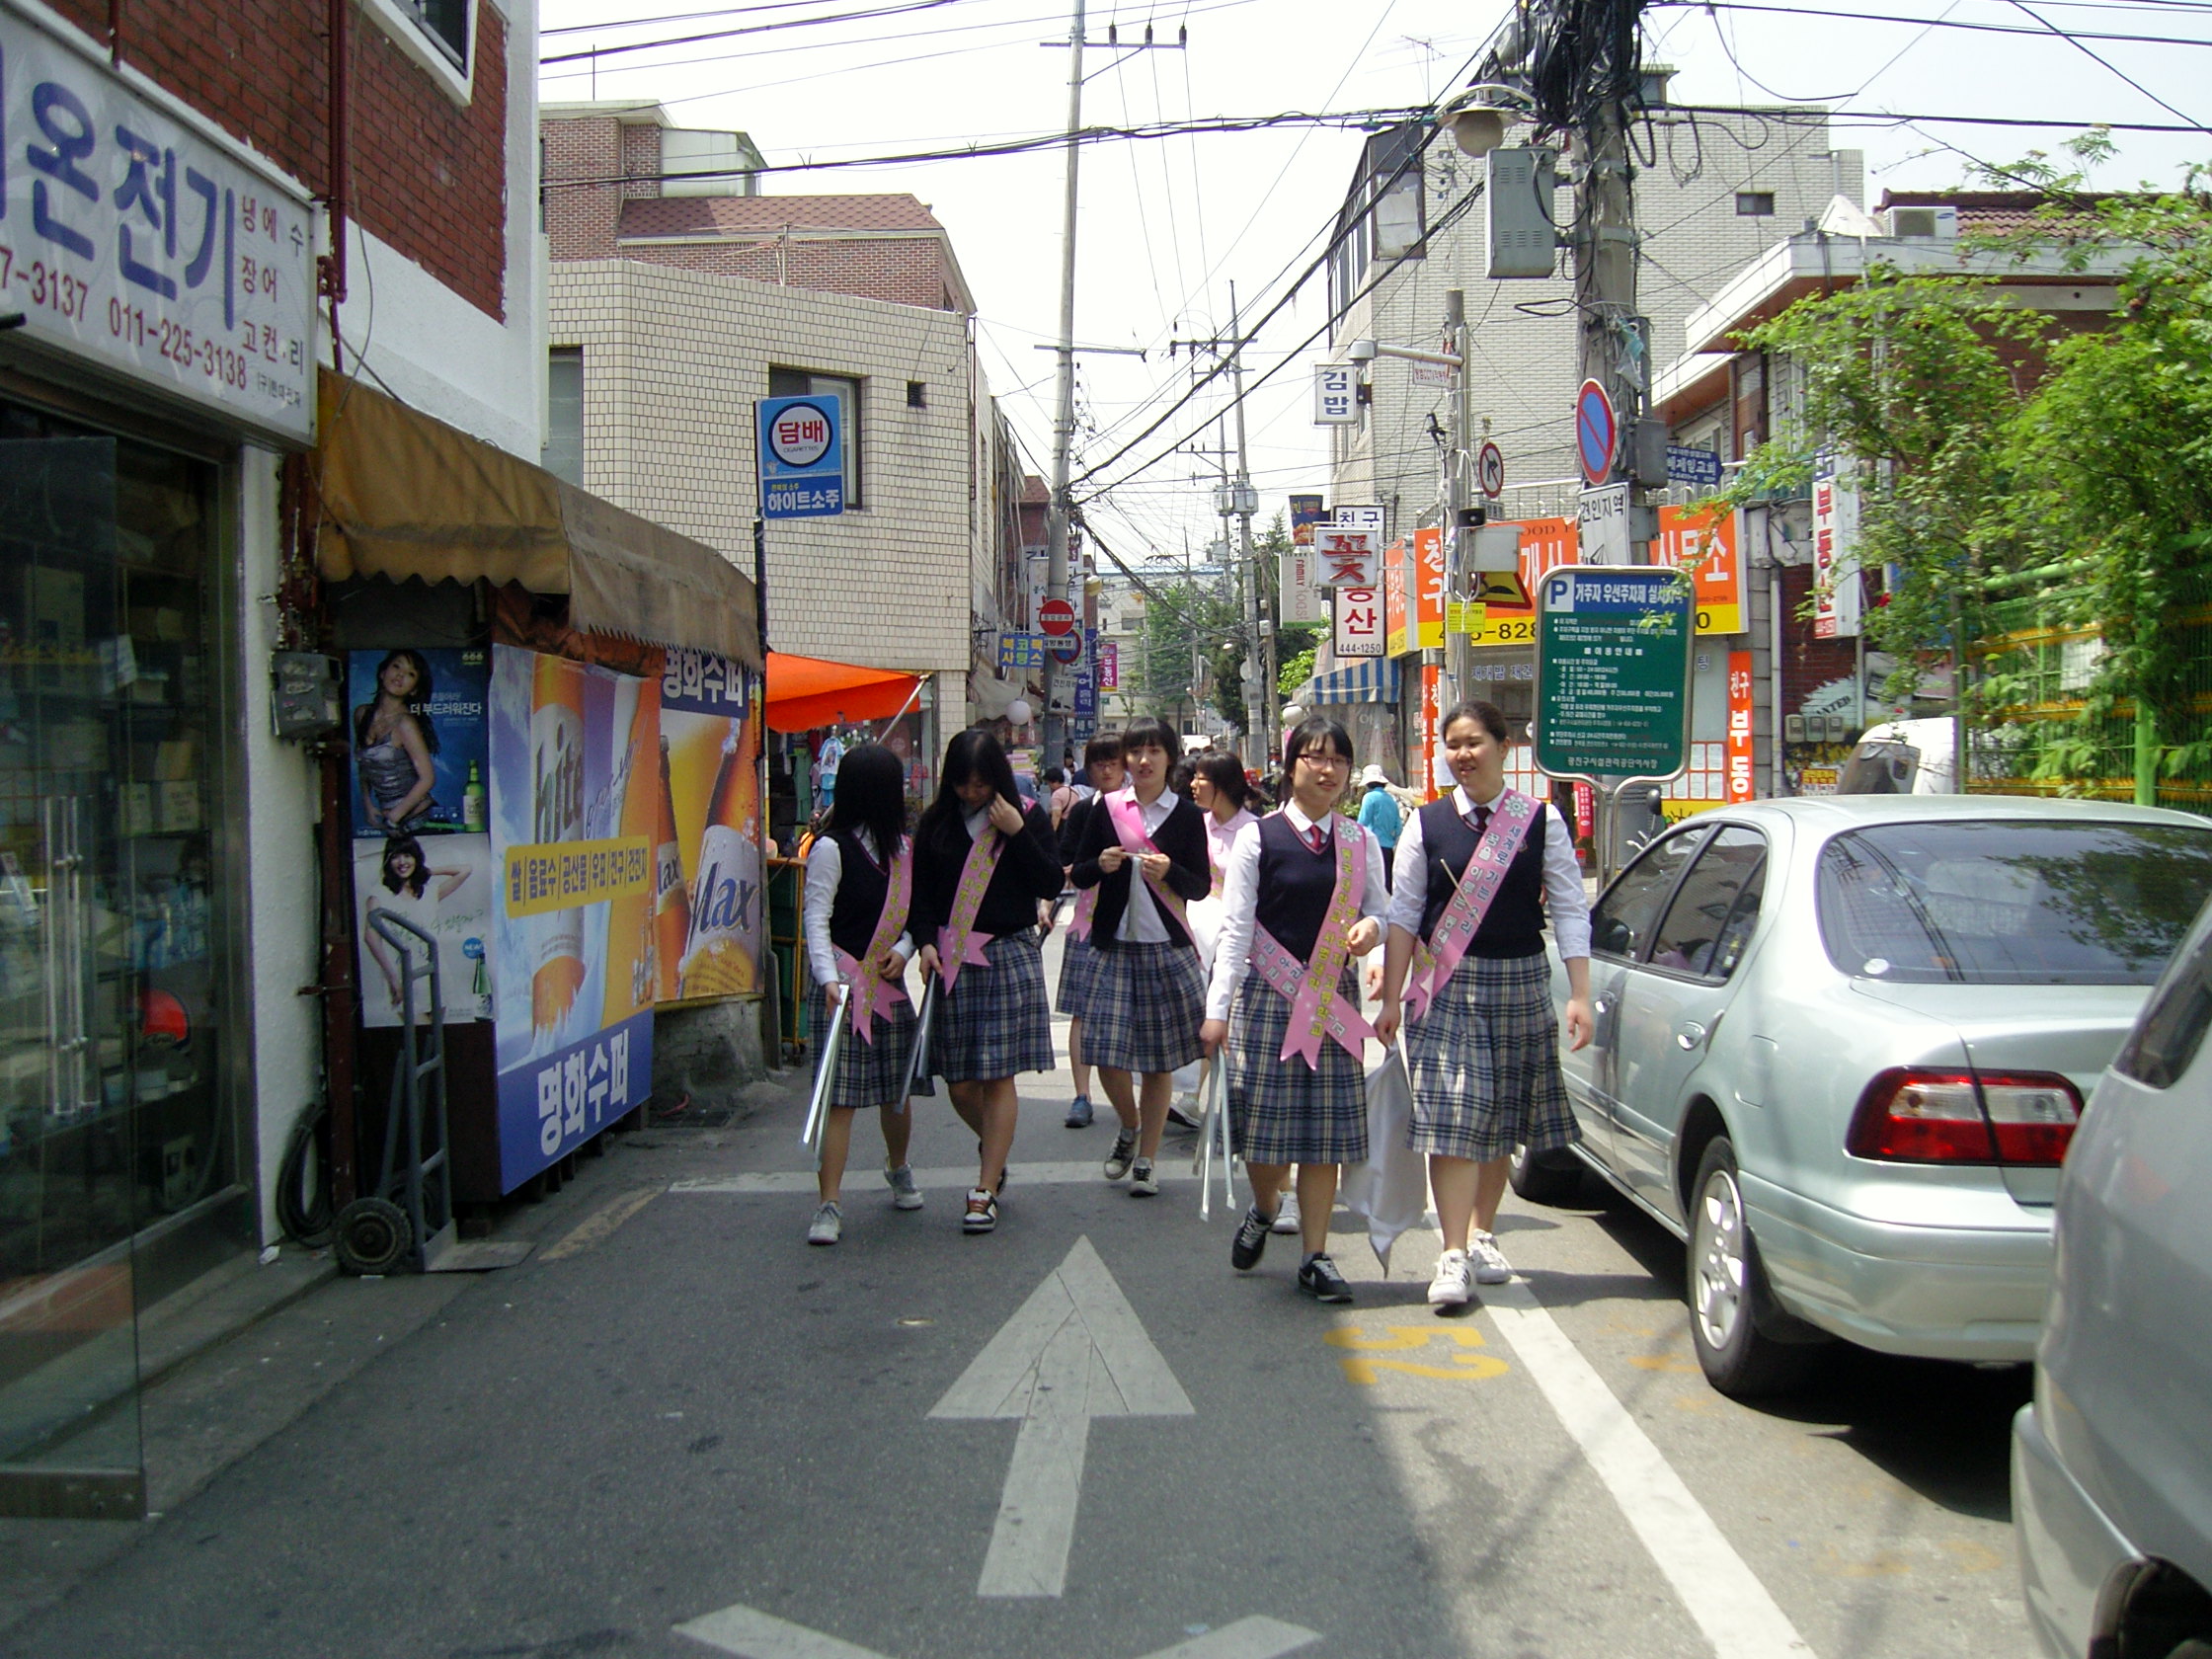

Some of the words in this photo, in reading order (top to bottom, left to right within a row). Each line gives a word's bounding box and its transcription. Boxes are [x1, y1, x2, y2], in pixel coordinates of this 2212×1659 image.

[0, 45, 235, 331] 온전기
[109, 297, 247, 391] 011-225-3138
[1323, 370, 1348, 416] 김밥
[778, 420, 824, 444] 담배
[767, 489, 839, 512] 하이트소주
[1580, 494, 1624, 522] 견인지역
[1320, 534, 1373, 583] 꽃
[1295, 559, 1305, 587] FAMILY
[1550, 580, 1567, 605] P
[1575, 584, 1601, 602] 거주자
[1604, 584, 1646, 603] 우선주차제
[1339, 643, 1382, 654] 444-1250
[663, 648, 744, 708] 명화수퍼
[1471, 665, 1506, 680] 재개발
[410, 703, 421, 716] 더
[423, 702, 482, 716] 부드러워진다
[1730, 709, 1750, 802] 부동
[529, 858, 556, 900] 음료수
[537, 1028, 629, 1156] 명화수퍼
